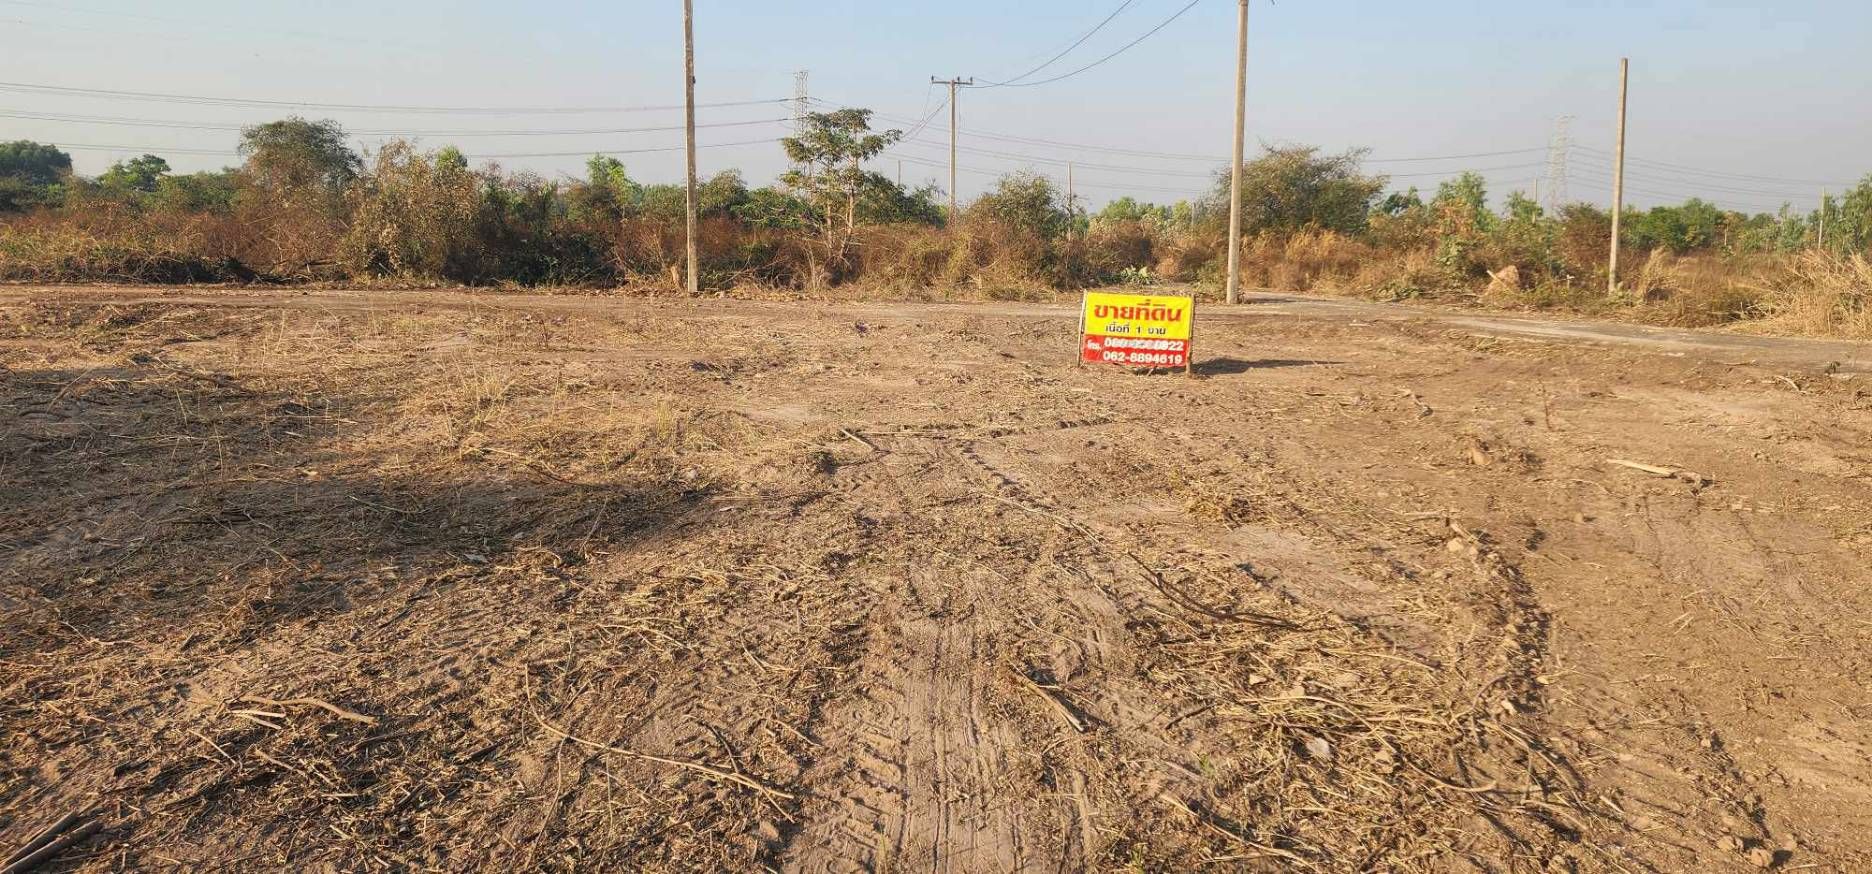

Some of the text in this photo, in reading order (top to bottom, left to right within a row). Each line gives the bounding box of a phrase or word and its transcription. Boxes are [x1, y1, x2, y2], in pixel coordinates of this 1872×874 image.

[1094, 299, 1182, 322] ขายที่ดิน
[1106, 321, 1130, 334] เนื้อที่
[1103, 351, 1183, 364] 062-8894619
